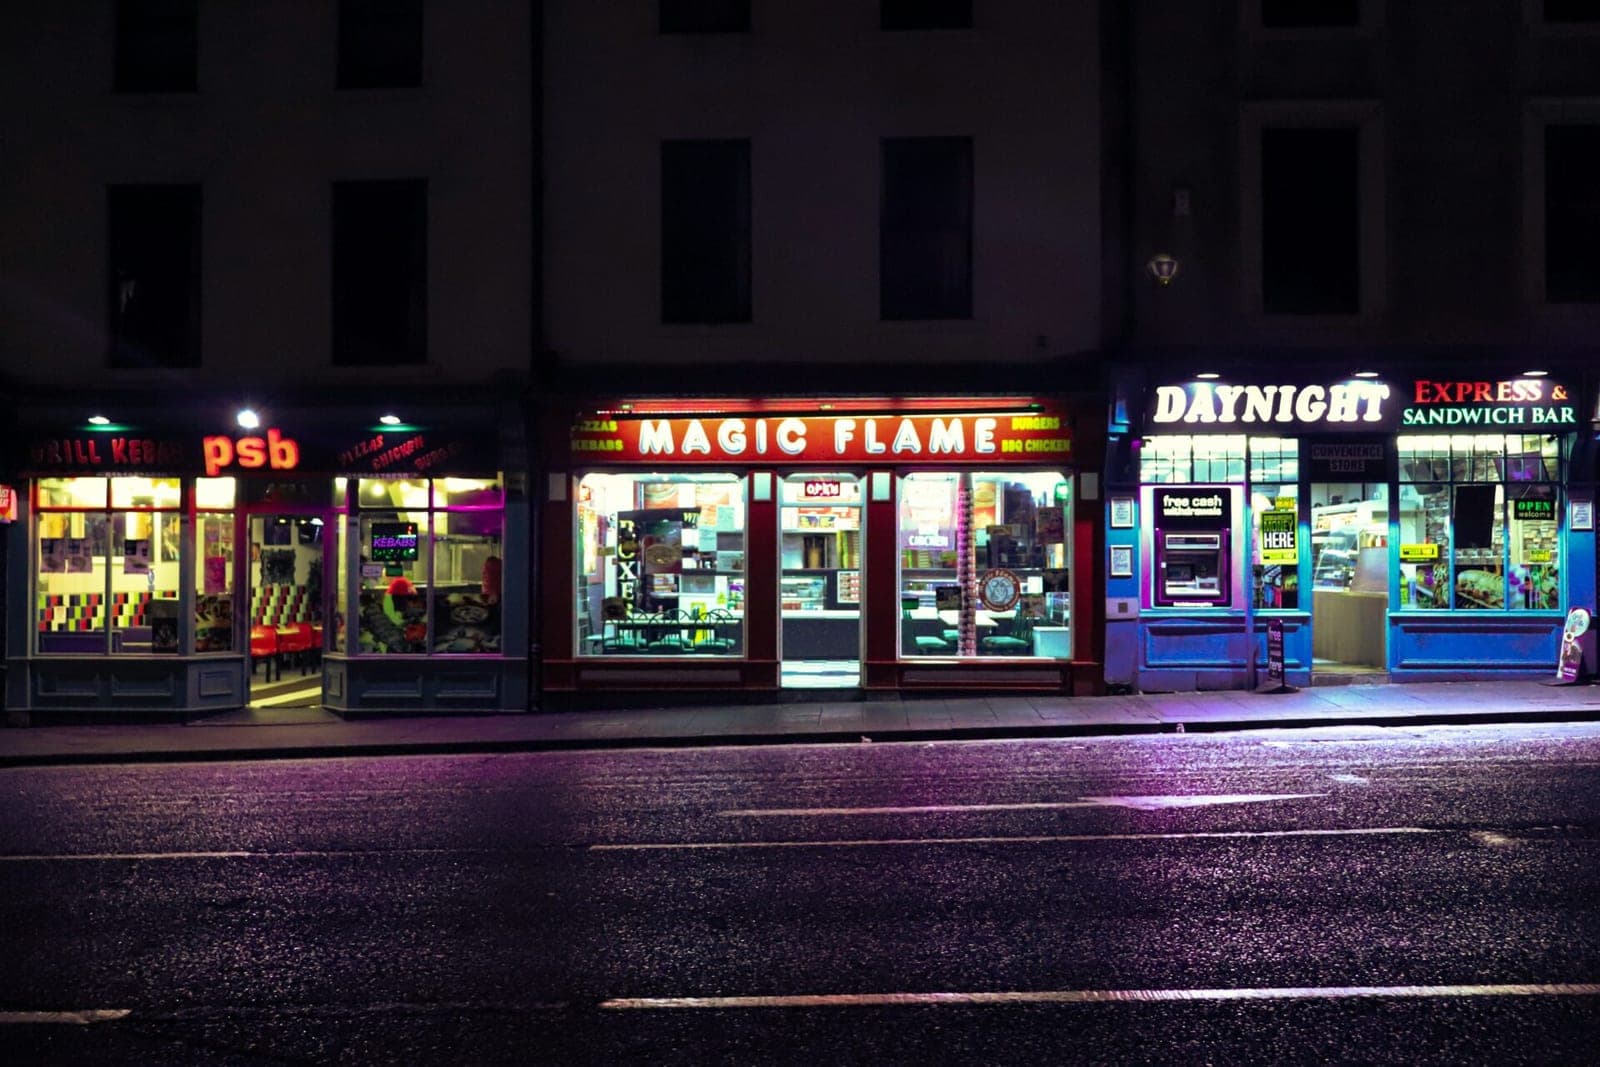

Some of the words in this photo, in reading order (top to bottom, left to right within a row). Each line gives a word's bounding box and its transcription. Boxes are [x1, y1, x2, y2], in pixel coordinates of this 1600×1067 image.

[1414, 380, 1542, 403] EXPRESS
[1551, 385, 1568, 400] &
[1153, 384, 1390, 423] DAYNIGHT
[1403, 407, 1523, 424] SANDWICH
[1532, 406, 1576, 424] BAR
[1011, 416, 1060, 430] BURGERS
[638, 419, 807, 455] MAGIC
[834, 417, 998, 454] FLAME
[202, 427, 299, 477] psb
[571, 439, 624, 452] KEBABS
[1001, 439, 1023, 453] BBQ
[1025, 439, 1071, 453] CHICKEN
[806, 483, 839, 496] OPEN
[1163, 494, 1190, 507] free
[1191, 494, 1222, 507] cash
[1518, 501, 1551, 511] OPEN
[373, 537, 416, 547] KEBABS
[1264, 531, 1294, 549] HERE
